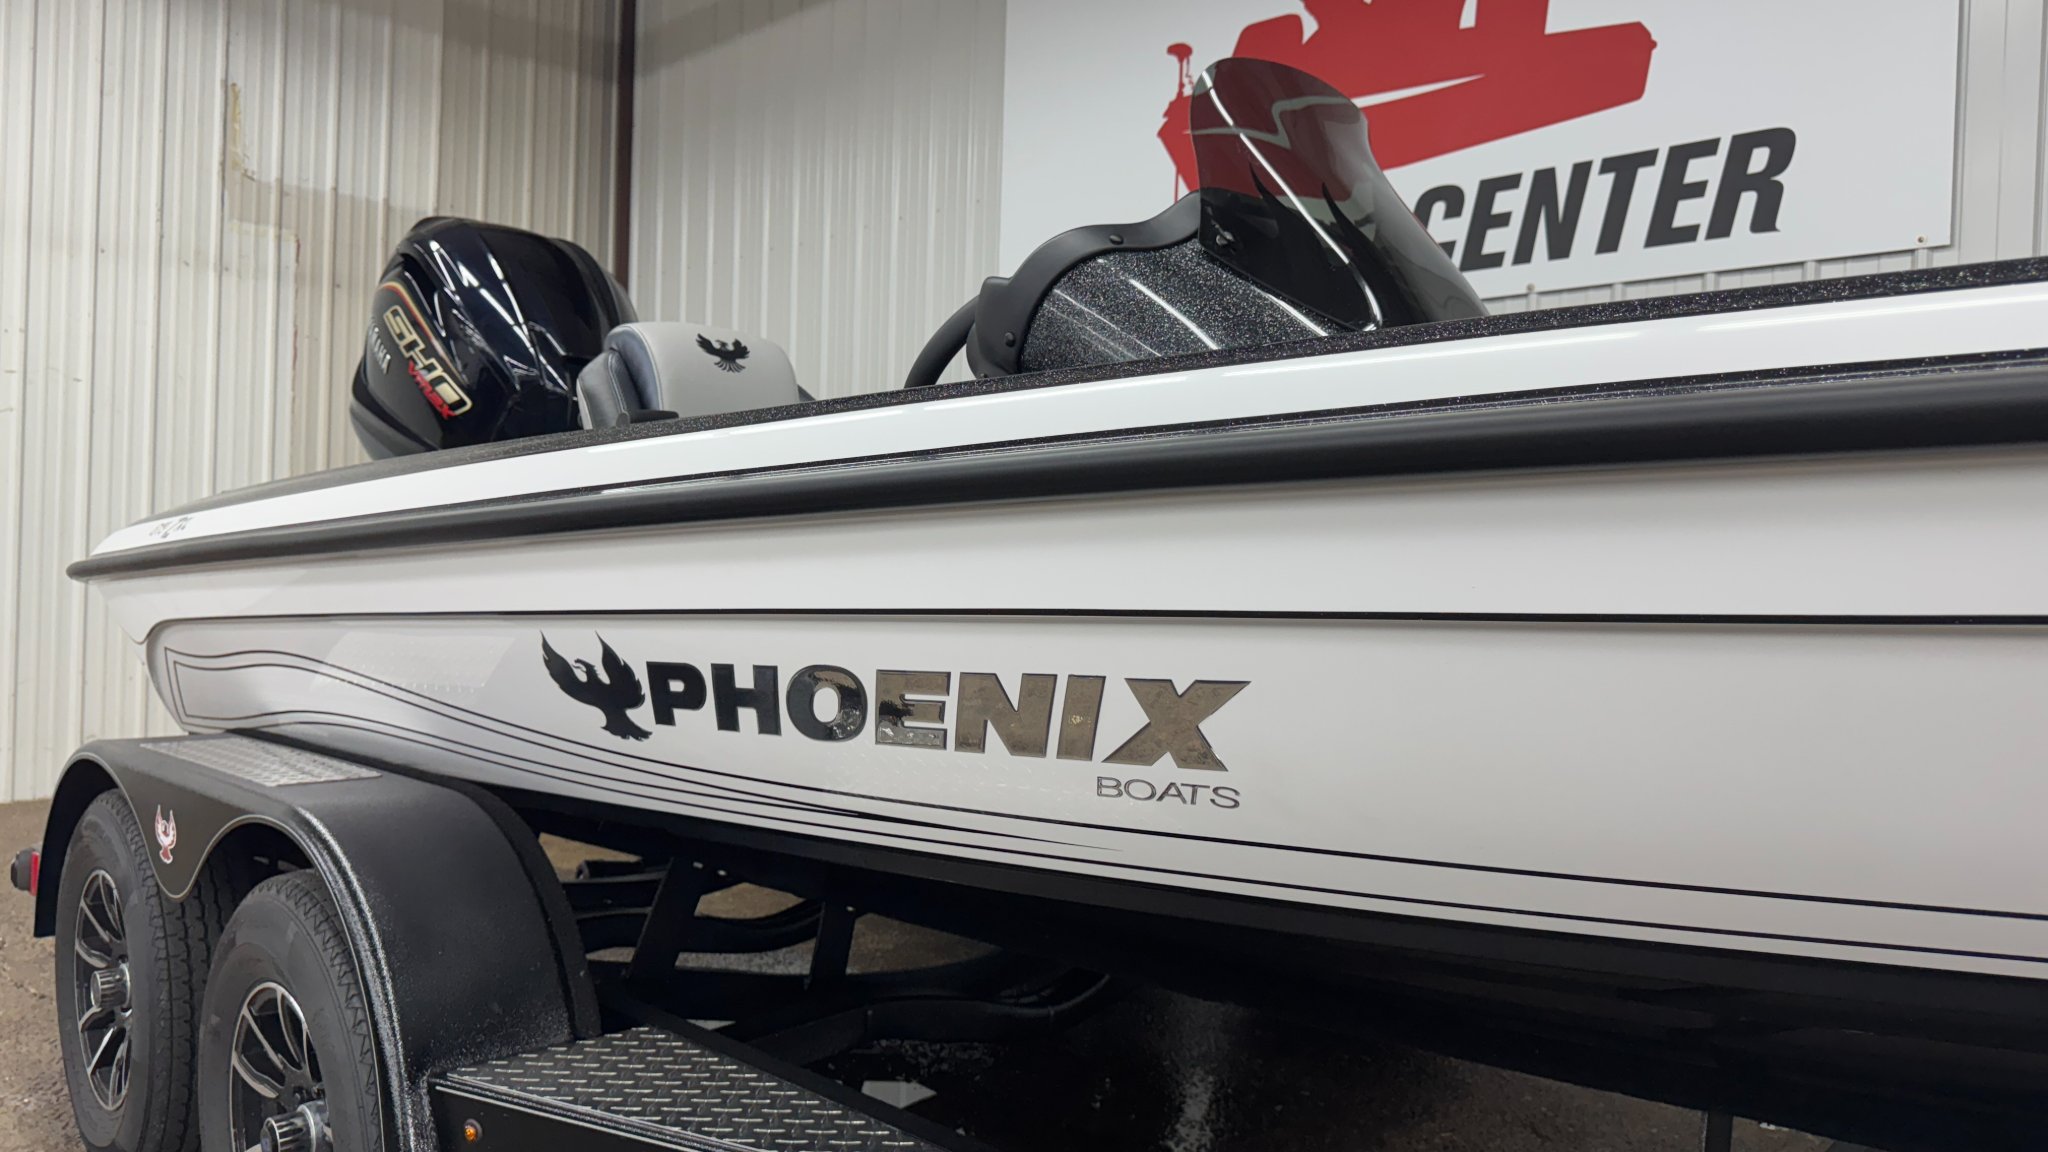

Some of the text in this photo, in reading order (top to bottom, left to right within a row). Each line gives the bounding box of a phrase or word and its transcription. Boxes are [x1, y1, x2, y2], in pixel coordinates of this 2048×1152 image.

[1413, 127, 1797, 272] CENTER
[383, 305, 473, 416] SHO
[646, 661, 1252, 772] PHOENIX
[1097, 776, 1240, 809] BOATS
